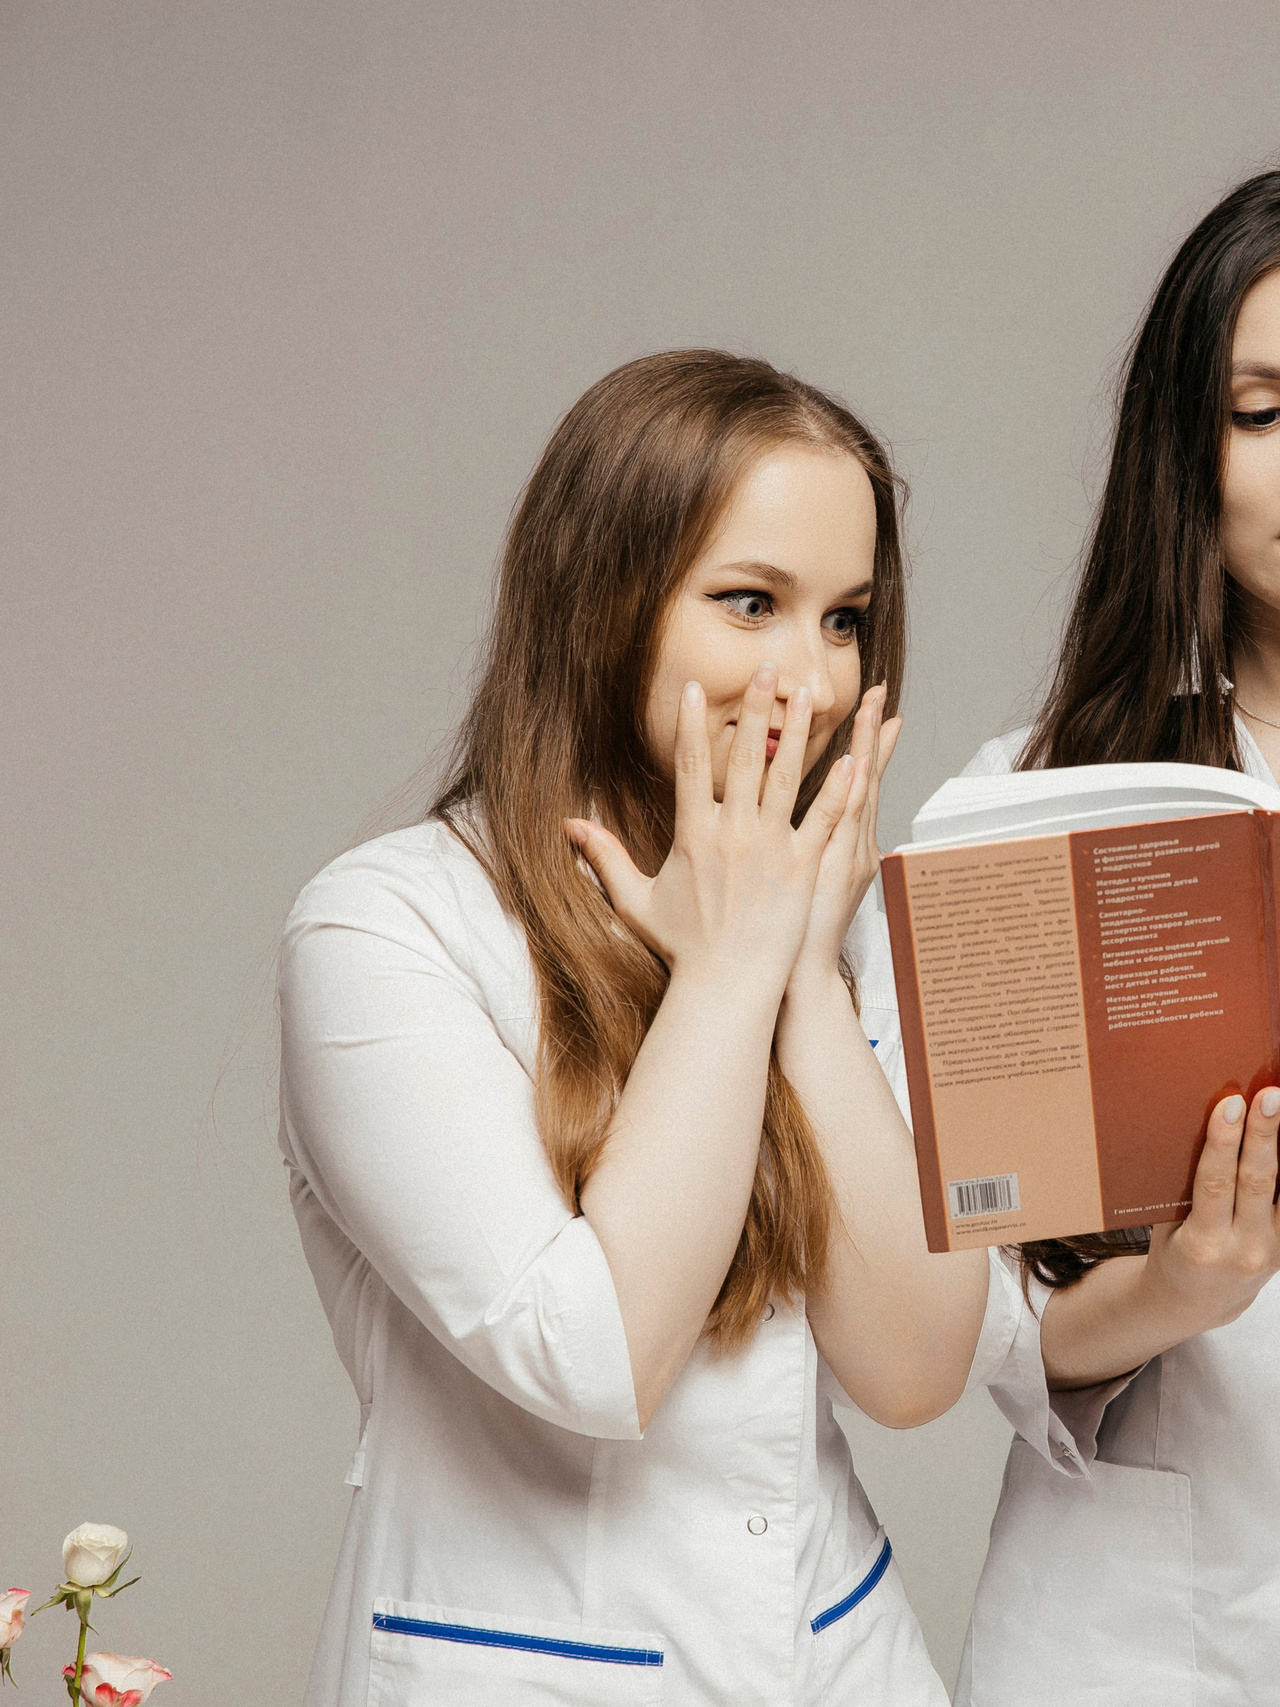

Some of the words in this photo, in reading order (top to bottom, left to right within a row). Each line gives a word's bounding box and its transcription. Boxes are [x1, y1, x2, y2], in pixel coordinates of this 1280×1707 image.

[1093, 843, 1138, 855] Состояние
[1139, 838, 1180, 851] здоровья
[1101, 850, 1153, 865] физическое
[1154, 846, 1194, 858] развитие
[1195, 841, 1220, 852] детей
[1102, 861, 1152, 874] подростков
[1096, 876, 1130, 888] Методы
[1130, 872, 1171, 885] изучения
[1104, 886, 1136, 896] оценки
[1137, 881, 1172, 891] питания
[1173, 877, 1198, 887] детей
[1105, 893, 1155, 906] подростков
[1099, 906, 1147, 921] Санитарно-
[1100, 926, 1148, 939] экспертиза
[1149, 921, 1183, 932] товаров
[1184, 916, 1222, 927] детского
[1101, 933, 1159, 947] ассортимента
[1102, 945, 1164, 959] Гигиеническая
[1165, 942, 1195, 952] оценка
[1196, 936, 1230, 948] детской
[1103, 957, 1134, 968] мебели
[1143, 949, 1203, 964] оборудования
[1104, 968, 1159, 983] Организация
[1160, 964, 1195, 976] рабочих
[1125, 978, 1150, 988] детей
[1159, 972, 1207, 985] подростков
[1106, 993, 1139, 1004] Методы
[1140, 989, 1179, 1001] изучения
[1107, 1003, 1140, 1014] режима
[1141, 1001, 1159, 1009] дня,
[1161, 992, 1218, 1006] двигательной
[1107, 1010, 1155, 1020] активности
[1108, 1013, 1188, 1031] работоспособности
[1189, 1009, 1224, 1021] ребенка
[1114, 1206, 1143, 1215] Гигиена
[1144, 1203, 1165, 1211] детей
